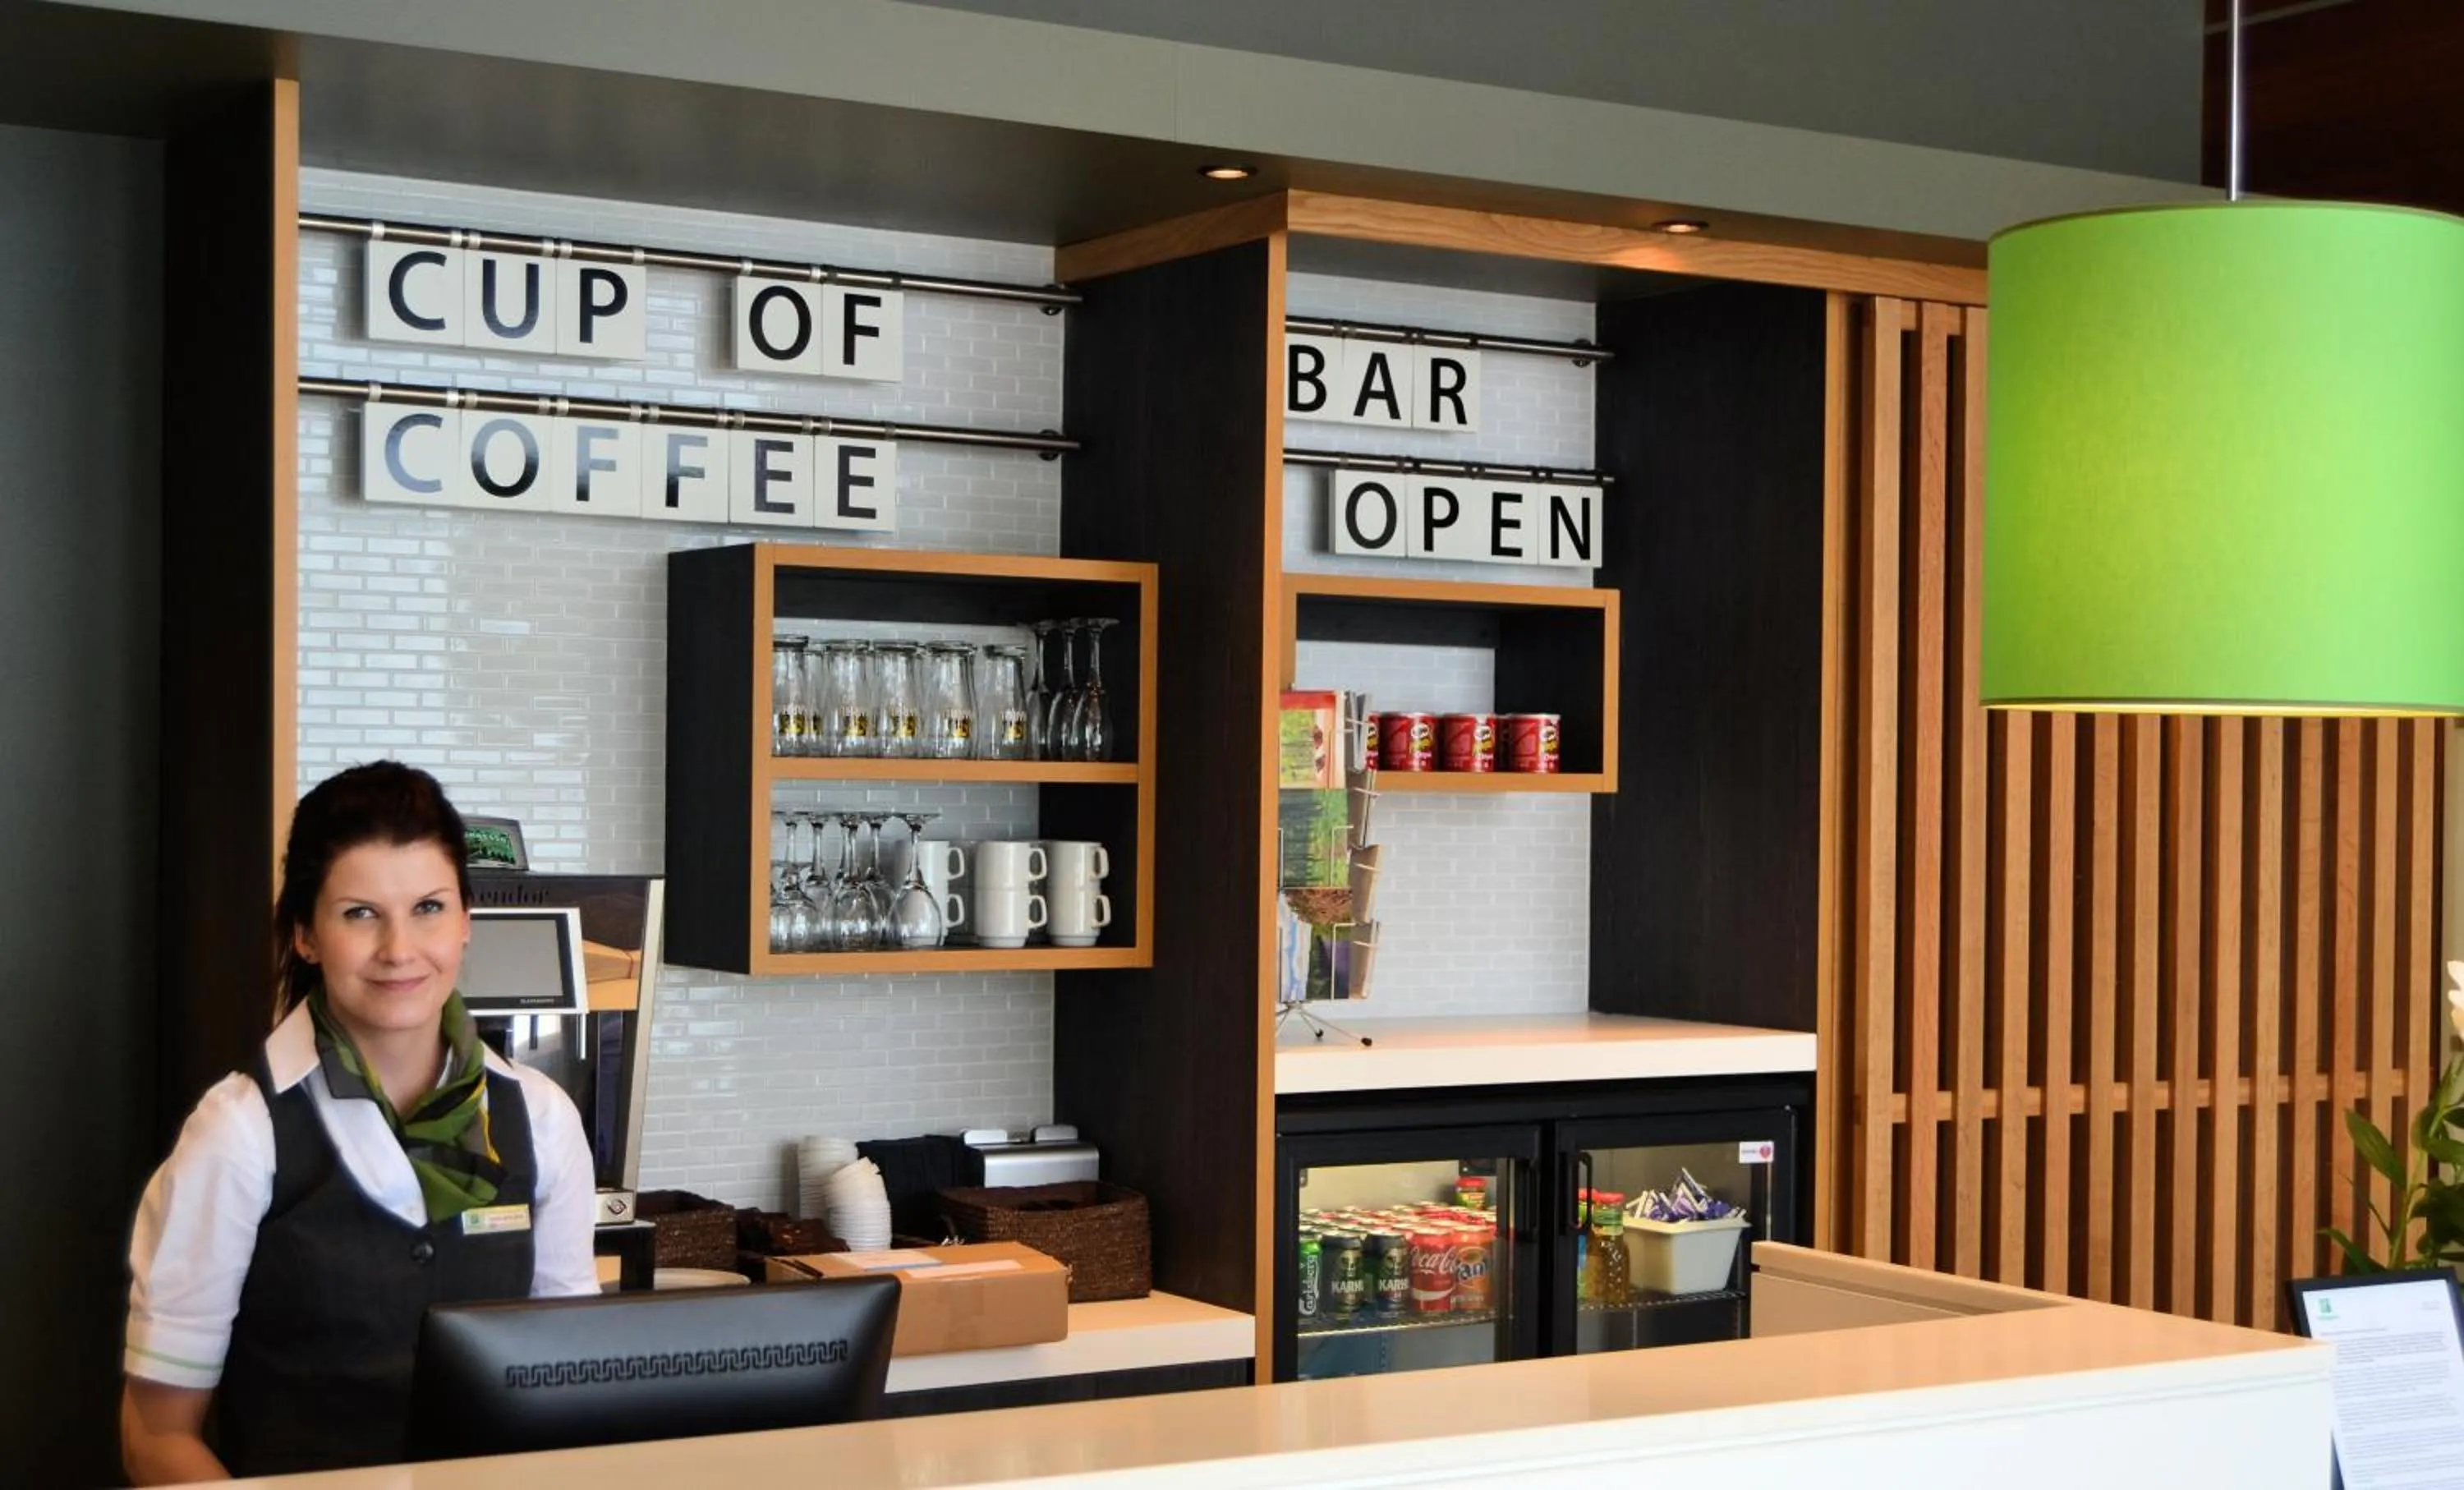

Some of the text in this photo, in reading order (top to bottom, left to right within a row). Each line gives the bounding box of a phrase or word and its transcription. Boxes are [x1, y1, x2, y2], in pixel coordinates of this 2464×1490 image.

[388, 250, 882, 366] CUP OF
[1286, 343, 1469, 425] BAR
[384, 412, 878, 520] COFFEE
[1345, 481, 1592, 560] OPEN
[472, 884, 551, 905] endor
